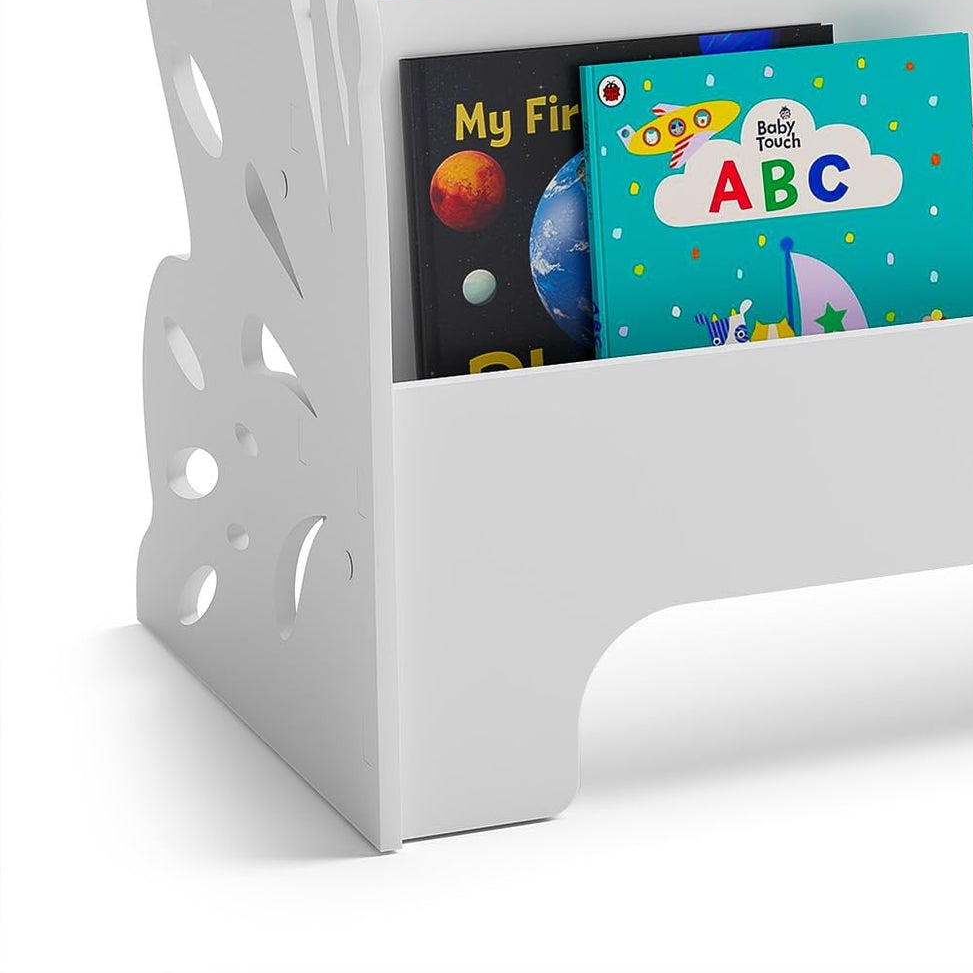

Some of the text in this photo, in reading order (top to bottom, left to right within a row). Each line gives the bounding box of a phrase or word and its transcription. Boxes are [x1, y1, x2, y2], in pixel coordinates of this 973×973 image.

[455, 94, 579, 148] My Fir
[756, 118, 801, 152] Baby Touch
[709, 153, 851, 214] ABC
